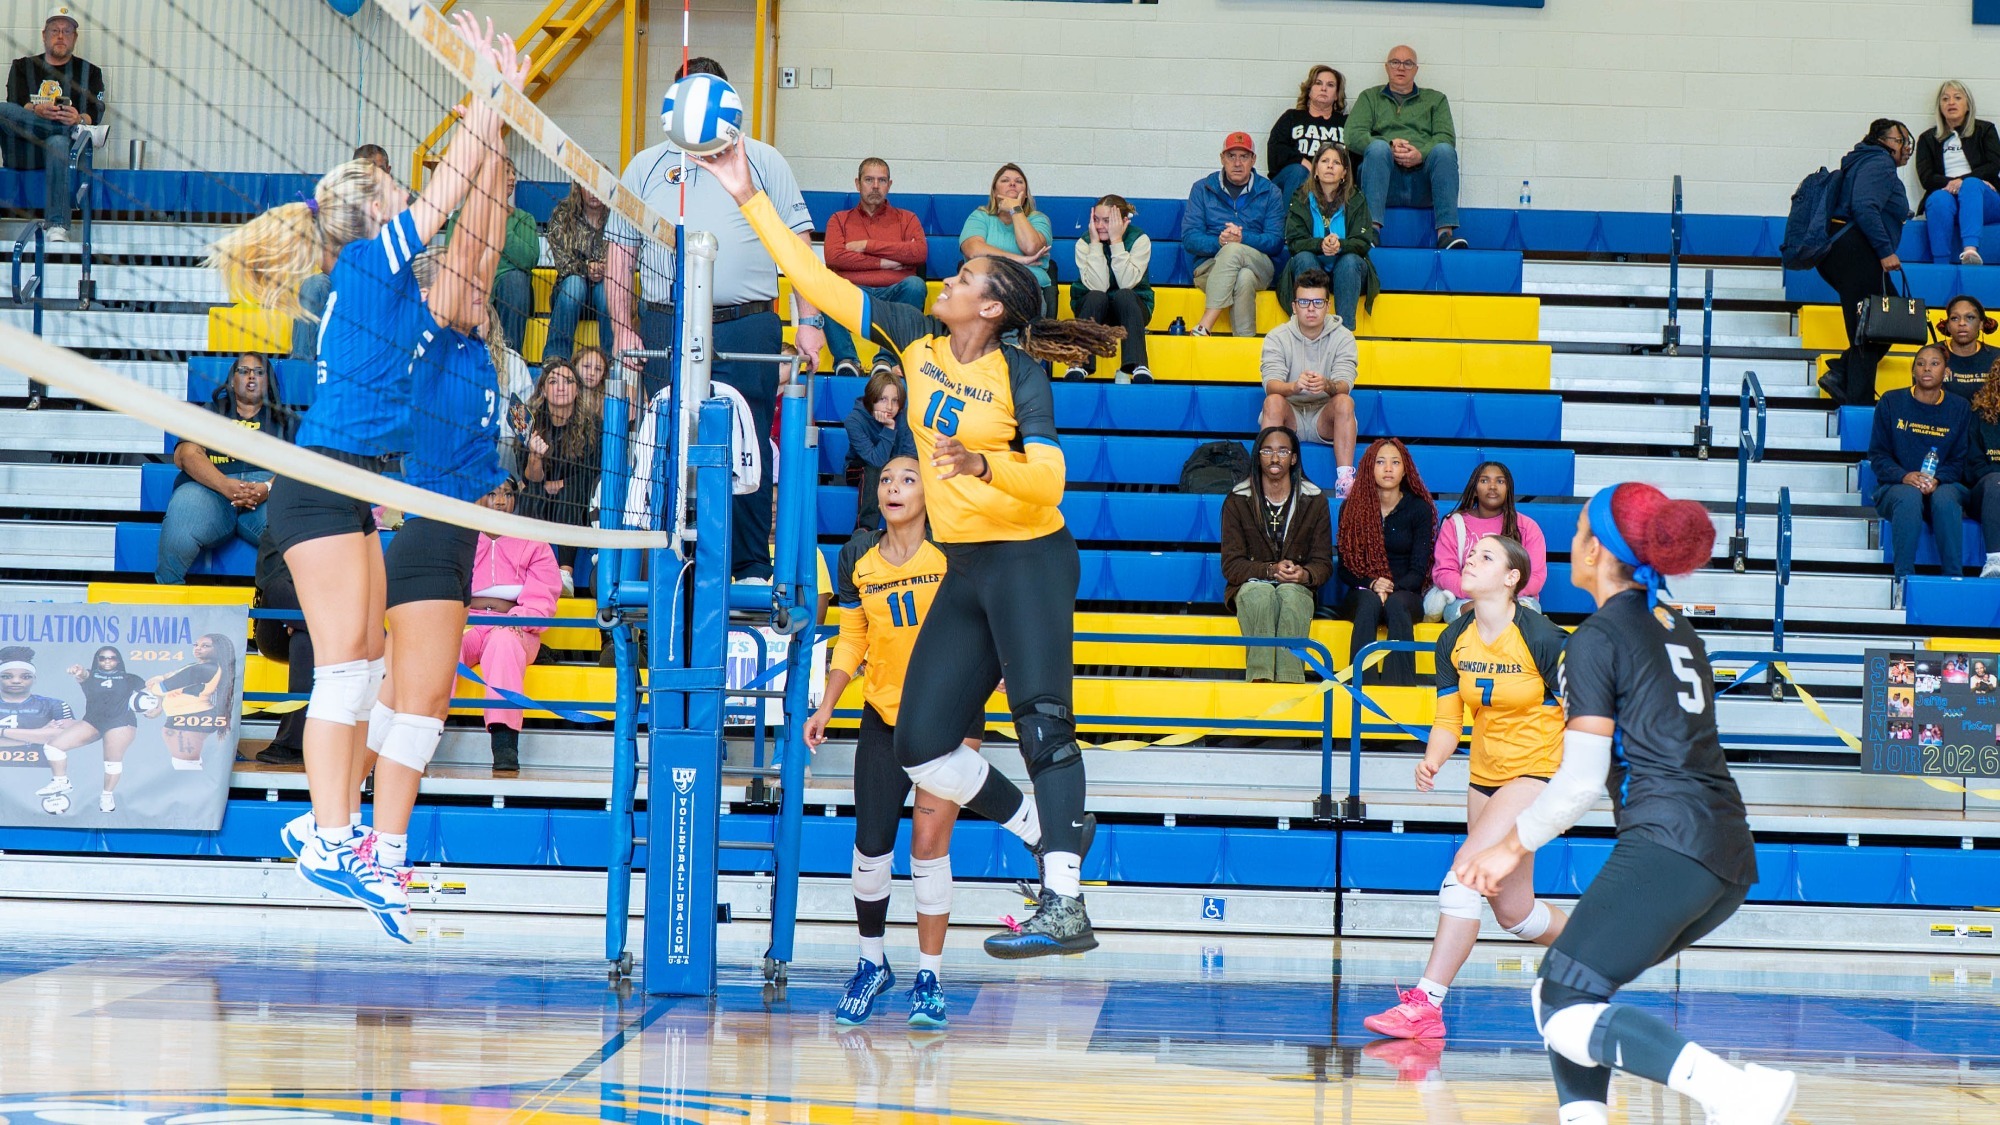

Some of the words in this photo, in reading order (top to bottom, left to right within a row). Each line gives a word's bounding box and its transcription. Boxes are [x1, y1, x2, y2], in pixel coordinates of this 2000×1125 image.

[1298, 138, 1320, 157] DA
[920, 361, 956, 390] JOHNSON
[956, 383, 962, 395] &
[964, 385, 994, 403] WALES
[924, 390, 966, 437] 15
[911, 574, 939, 585] WALES
[887, 591, 919, 627] 11
[0, 614, 120, 644] TULATIONS
[127, 615, 193, 644] JAMIA
[130, 650, 185, 661] 2024
[1496, 664, 1522, 674] WALES
[1665, 643, 1706, 714] 5
[100, 679, 113, 688] 4
[1475, 678, 1494, 707] 7
[173, 716, 227, 727] 2025
[0, 751, 39, 762] 023
[1922, 744, 1999, 775] 2026
